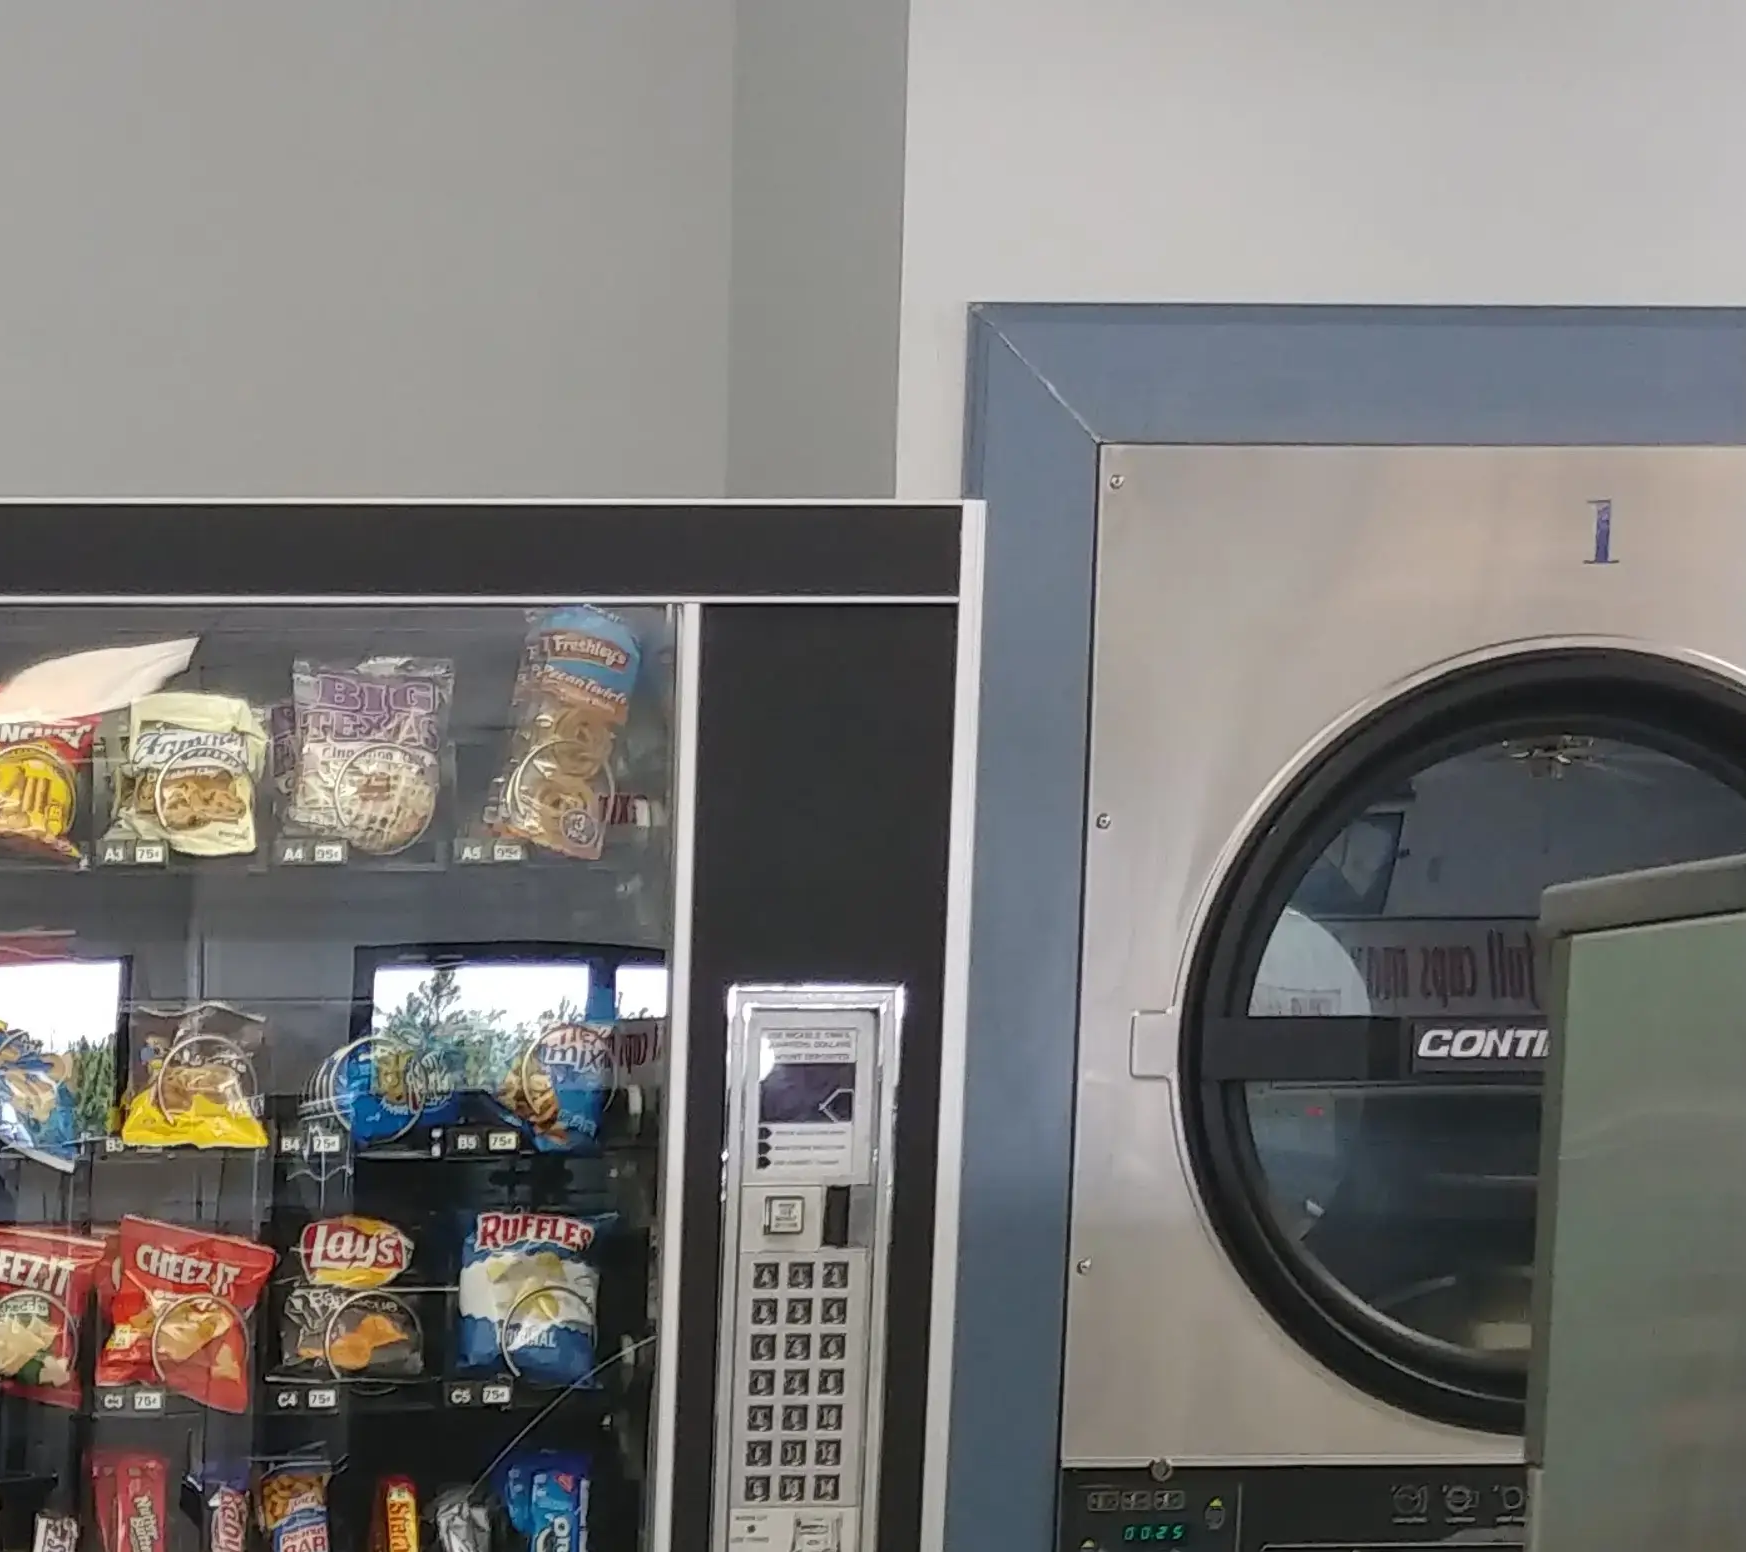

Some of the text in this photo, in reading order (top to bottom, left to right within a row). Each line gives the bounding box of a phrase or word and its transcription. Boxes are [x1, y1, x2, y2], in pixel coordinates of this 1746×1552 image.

[1583, 499, 1619, 565] 1
[553, 633, 627, 666] Freshley's
[316, 673, 435, 714] BIG
[301, 709, 440, 750] TEXAS
[1417, 1028, 1550, 1059] CONTI
[309, 1224, 399, 1269] Lay's
[478, 1213, 593, 1251] RUFFLES
